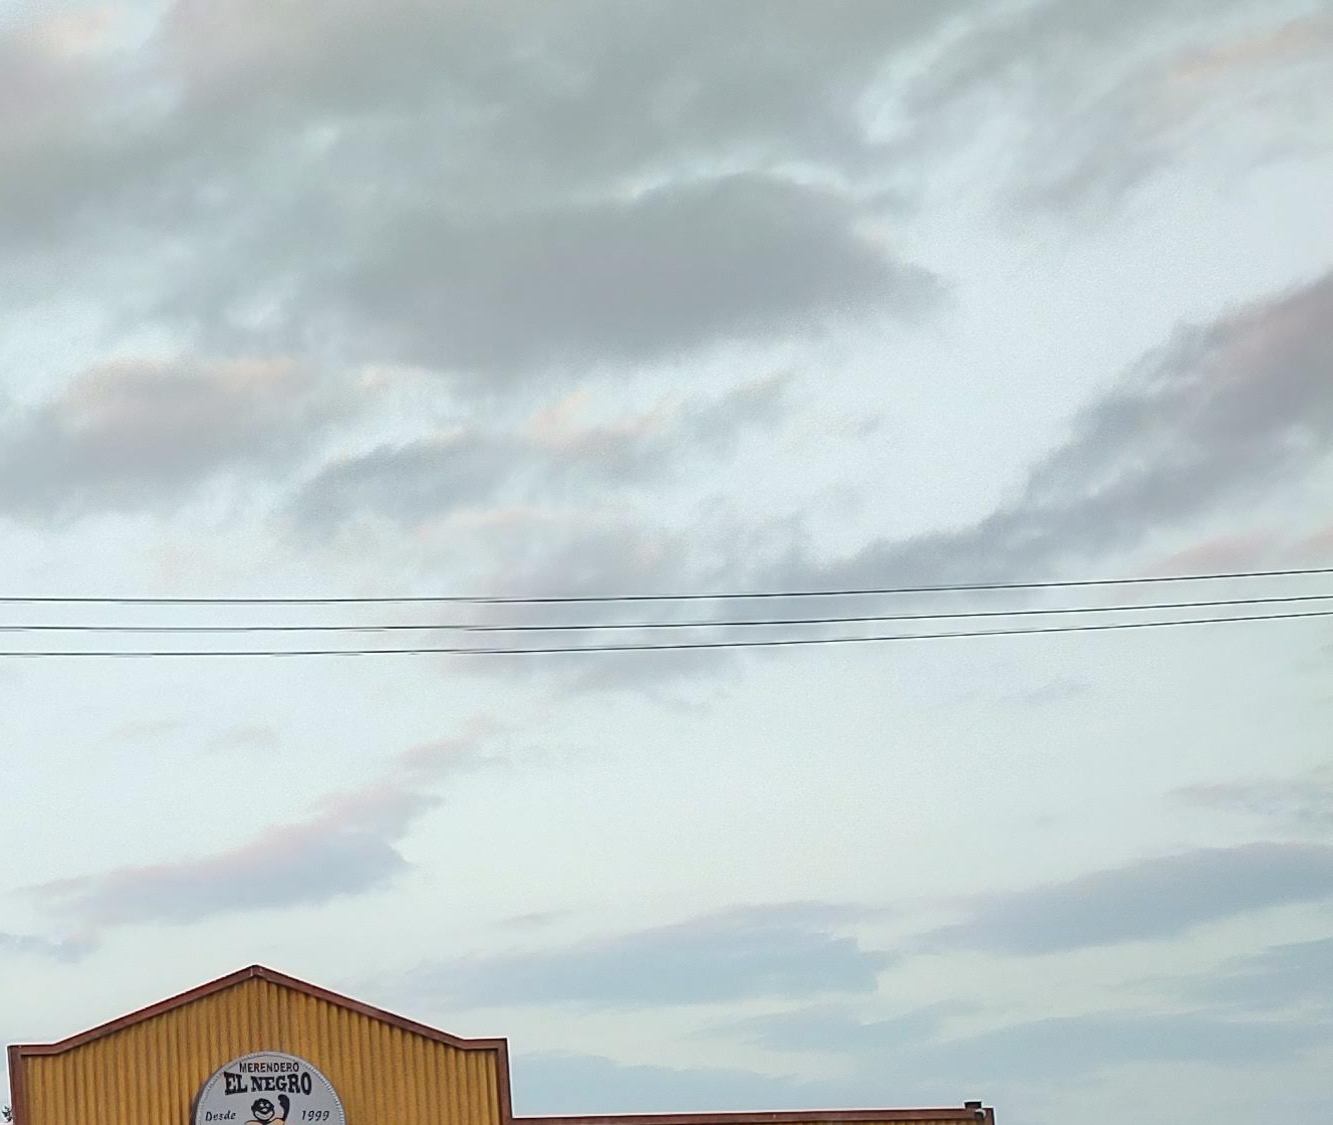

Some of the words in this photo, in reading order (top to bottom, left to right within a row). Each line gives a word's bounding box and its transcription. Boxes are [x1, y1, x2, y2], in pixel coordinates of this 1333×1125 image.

[239, 1062, 300, 1073] MERENDERO
[223, 1071, 248, 1096] EL
[251, 1072, 312, 1096] NEGRO
[205, 1110, 237, 1122] Desde
[301, 1110, 330, 1122] 1999
